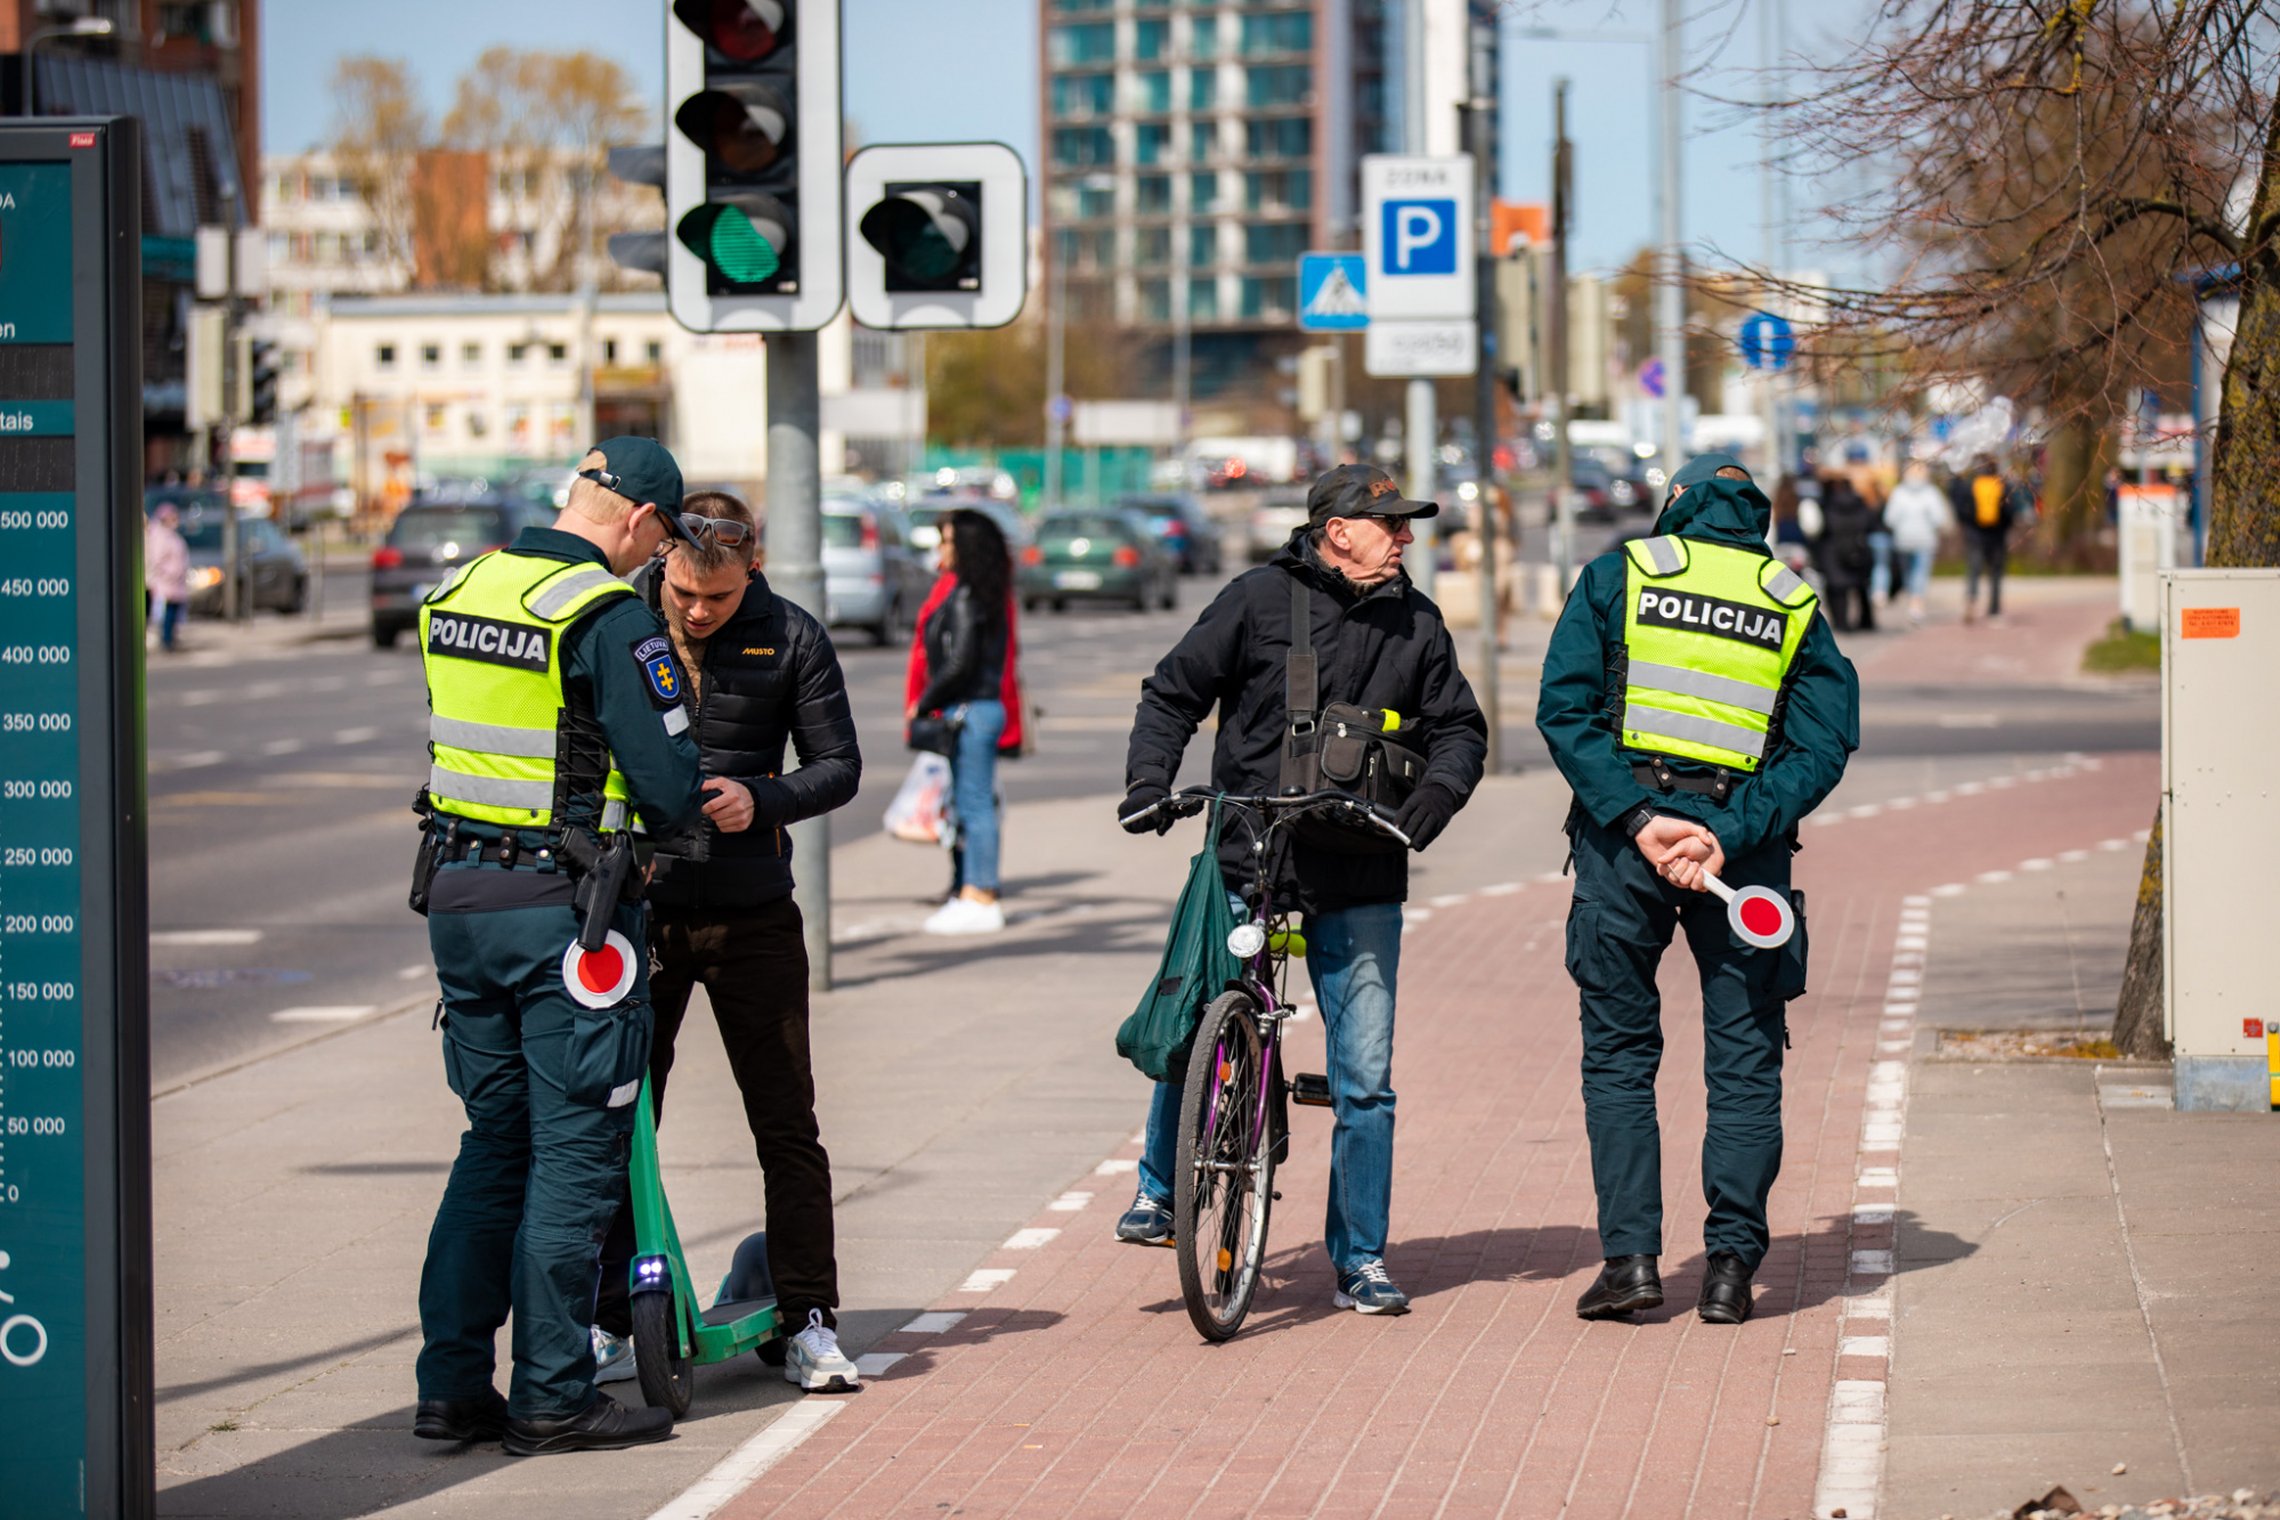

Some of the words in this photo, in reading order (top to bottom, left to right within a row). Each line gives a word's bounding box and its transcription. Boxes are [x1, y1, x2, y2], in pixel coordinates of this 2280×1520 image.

[1396, 206, 1442, 270] P
[1, 510, 32, 529] 500
[36, 510, 69, 529] 000
[1, 578, 33, 597] 450
[37, 578, 70, 597] 000
[1637, 591, 1783, 645] POLICIJA
[429, 615, 548, 664] POLICIJA
[2, 645, 34, 664] 400
[38, 645, 71, 664] 000
[742, 647, 775, 656] MUSTO
[3, 713, 35, 731] 350
[39, 713, 71, 731] 000
[4, 780, 36, 799] 300
[40, 780, 72, 799] 000
[5, 848, 37, 866] 250
[41, 848, 73, 866] 000
[5, 915, 37, 933] 200
[42, 915, 74, 933] 000
[7, 982, 38, 1000] 150
[42, 982, 75, 1000] 000
[8, 1050, 39, 1068] 100
[43, 1050, 75, 1068] 000
[8, 1116, 29, 1136] 50
[33, 1116, 66, 1136] 000
[8, 1184, 20, 1204] 0
